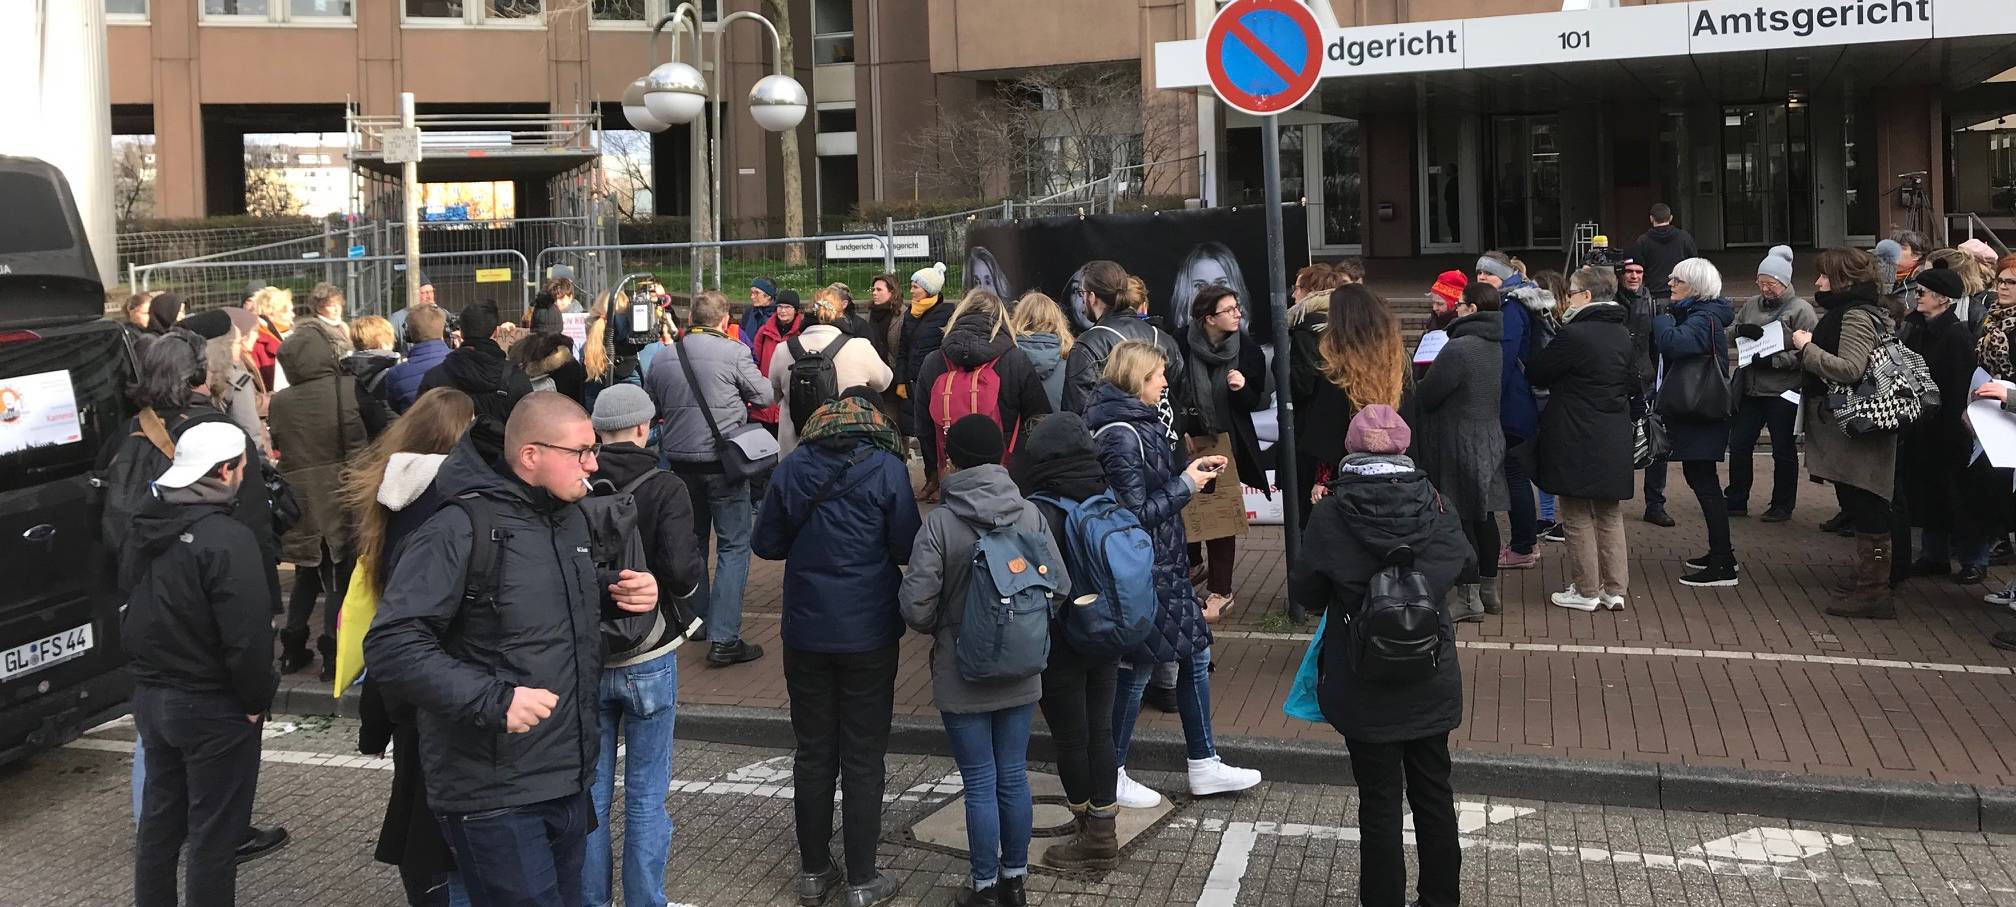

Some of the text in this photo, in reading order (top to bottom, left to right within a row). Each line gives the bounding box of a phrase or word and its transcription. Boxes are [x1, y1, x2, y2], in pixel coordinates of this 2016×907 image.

[1692, 0, 1930, 37] Amtsgericht
[1327, 30, 1457, 66] dgericht
[1558, 30, 1590, 49] 101
[835, 242, 919, 251] Landgericht Asgericht
[5, 628, 86, 672] GL FS 44
